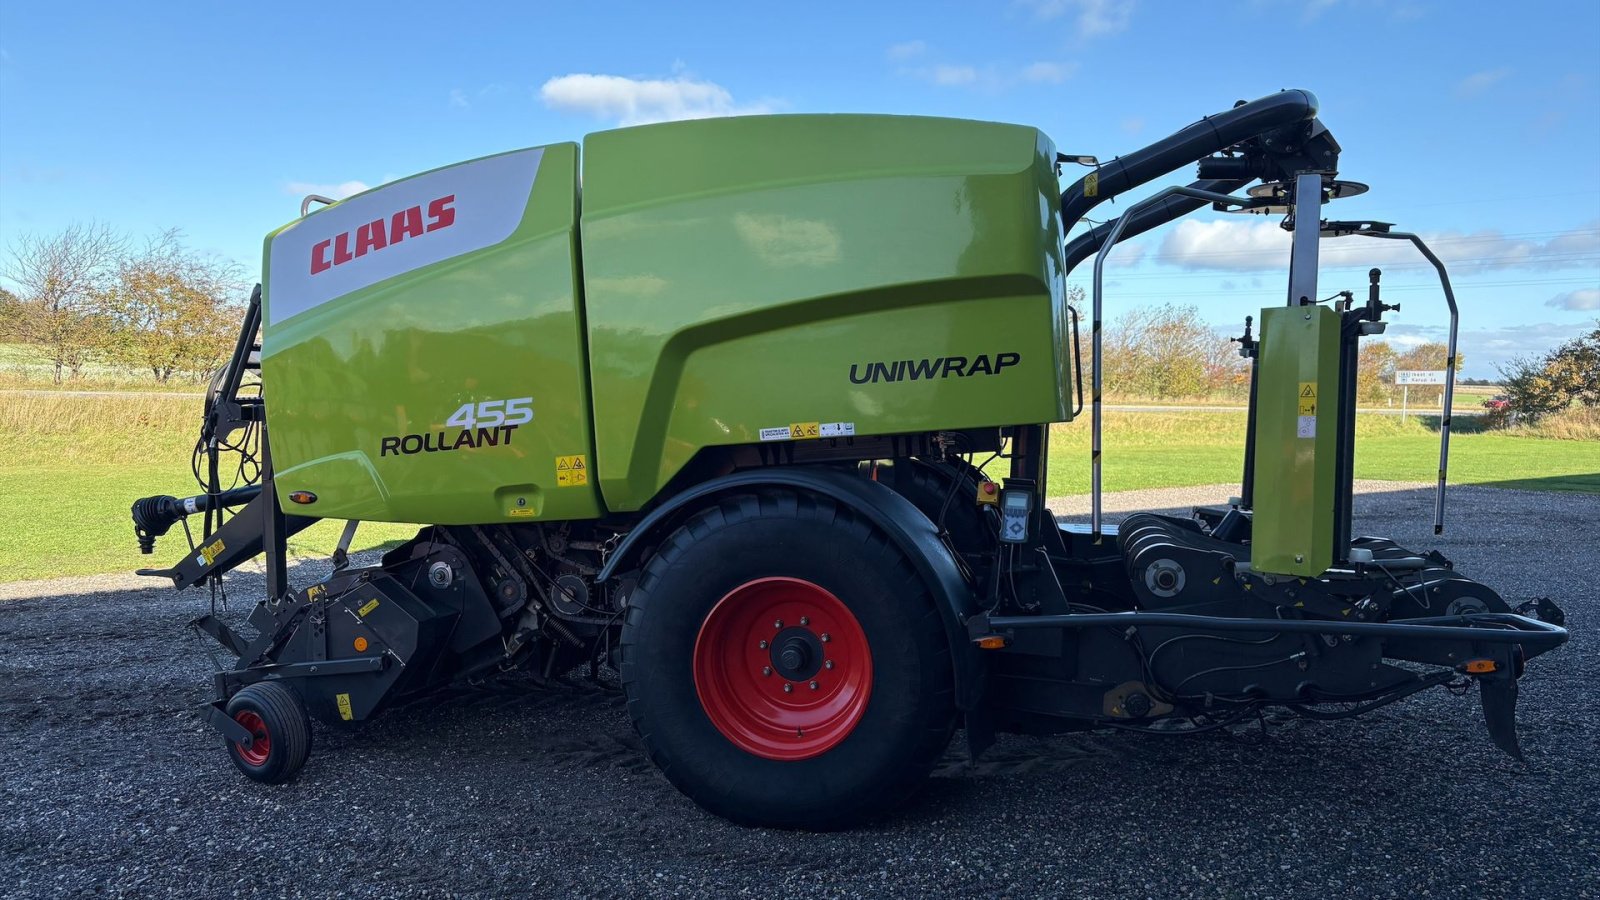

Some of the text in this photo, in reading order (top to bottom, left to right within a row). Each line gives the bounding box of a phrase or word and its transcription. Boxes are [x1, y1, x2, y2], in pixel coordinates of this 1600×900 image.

[310, 194, 456, 275] CLAAS
[849, 352, 1021, 384] UNIWRAP
[446, 397, 533, 430] 455
[380, 424, 518, 457] ROLLANT
